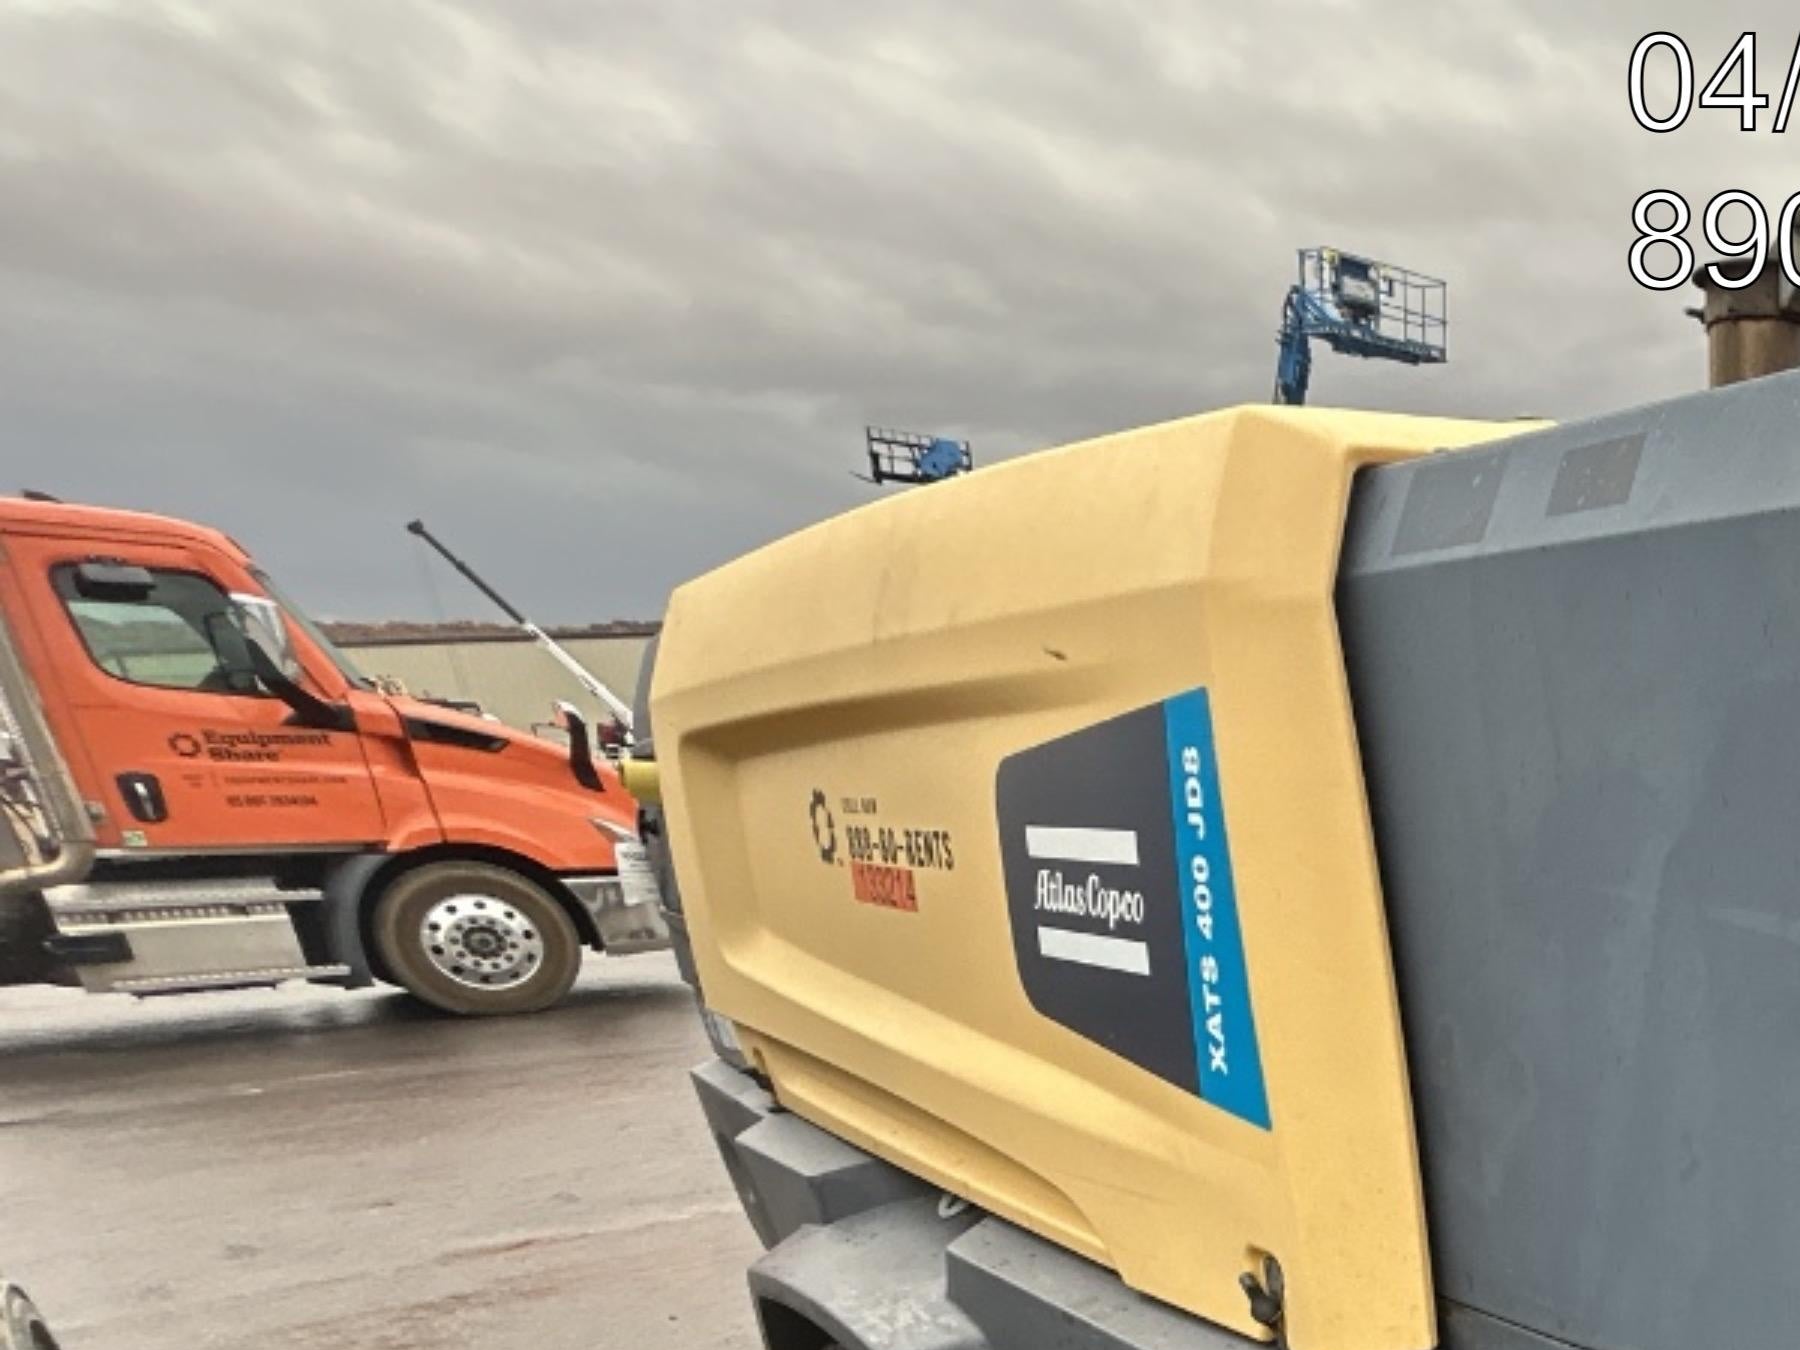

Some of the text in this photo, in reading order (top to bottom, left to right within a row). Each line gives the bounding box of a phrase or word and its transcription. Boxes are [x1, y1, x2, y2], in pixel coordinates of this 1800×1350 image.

[201, 729, 331, 748] Equipment
[207, 747, 280, 762] Share
[1034, 868, 1144, 930] Atlas Copco
[1191, 854, 1213, 941] 400
[1200, 954, 1228, 1076] XATS
